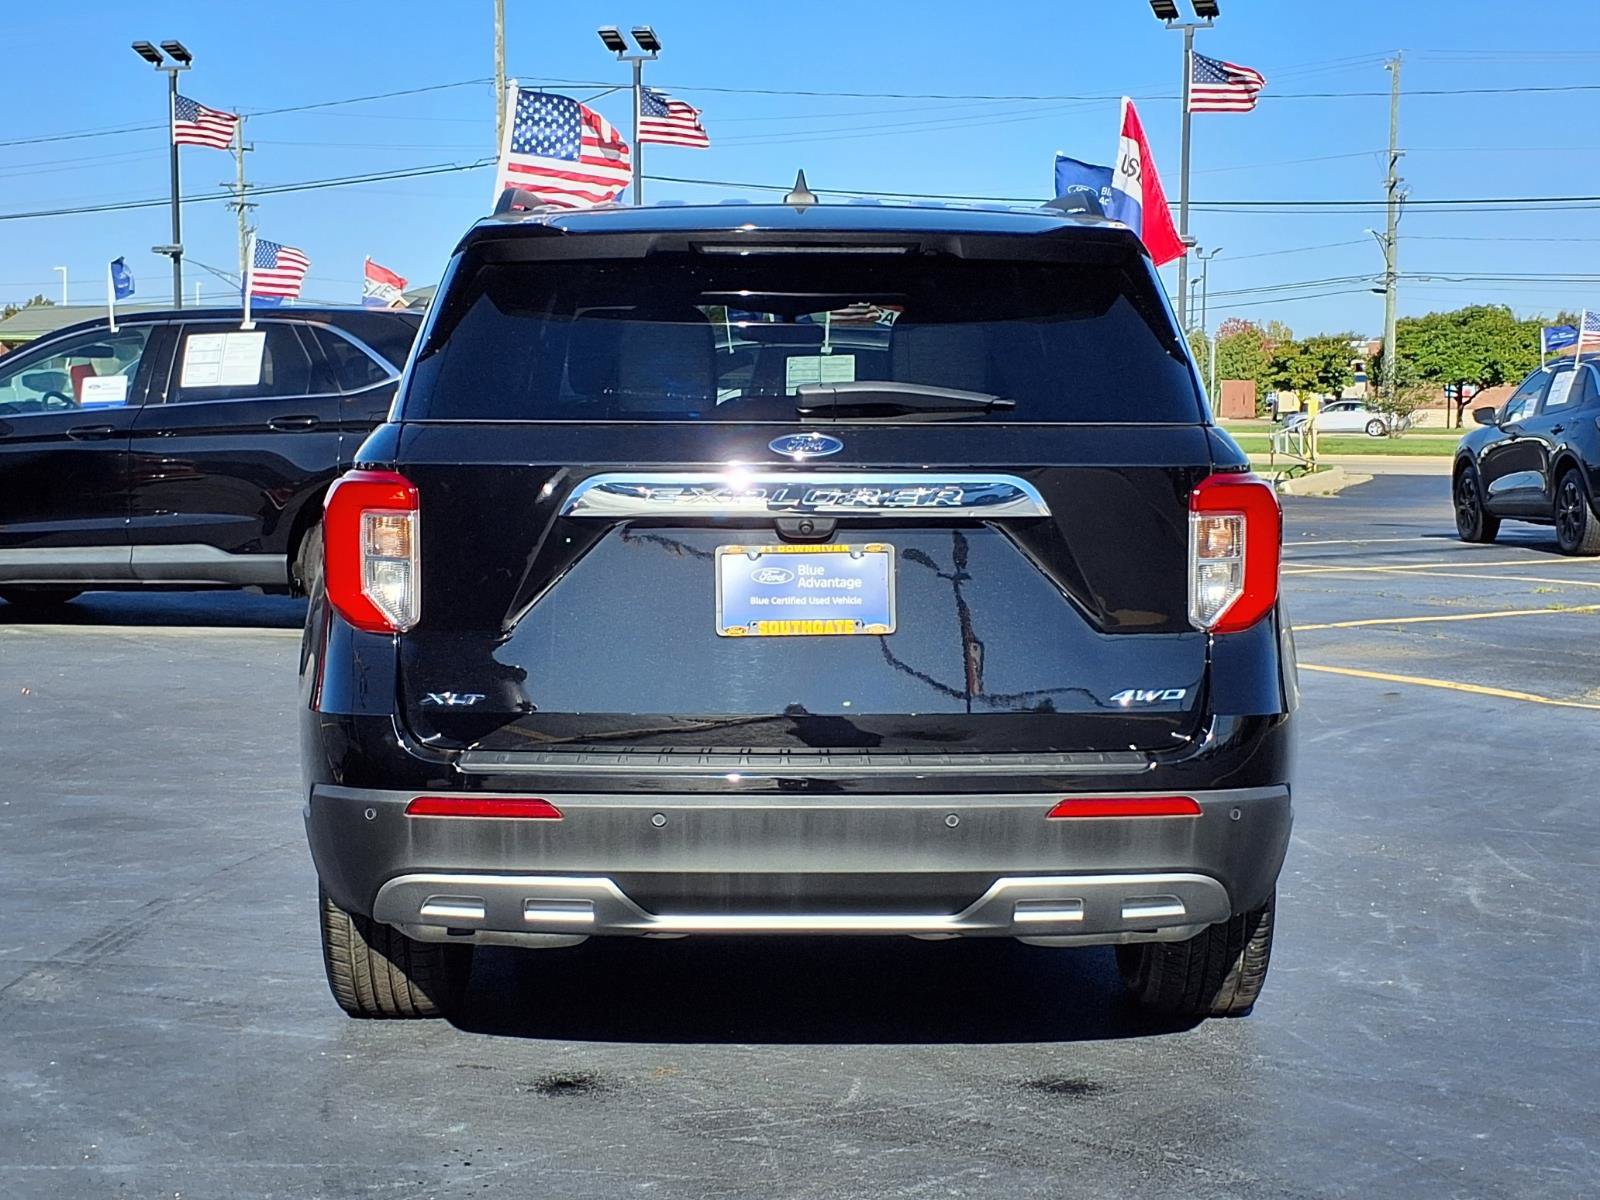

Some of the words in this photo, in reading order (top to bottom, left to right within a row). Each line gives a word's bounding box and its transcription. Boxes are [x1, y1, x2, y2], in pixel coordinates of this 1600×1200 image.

[645, 486, 964, 506] EXPLORER
[777, 544, 850, 553] DOWNRIVER
[797, 564, 825, 576] Blue
[797, 577, 862, 590] Advantage
[750, 596, 769, 605] Blue
[771, 596, 807, 605] Certified
[808, 596, 831, 605] Used
[832, 596, 862, 605] Vehicle
[758, 620, 856, 634] SOUTHGATE
[419, 691, 487, 705] XLT
[1110, 688, 1187, 706] 4WD
